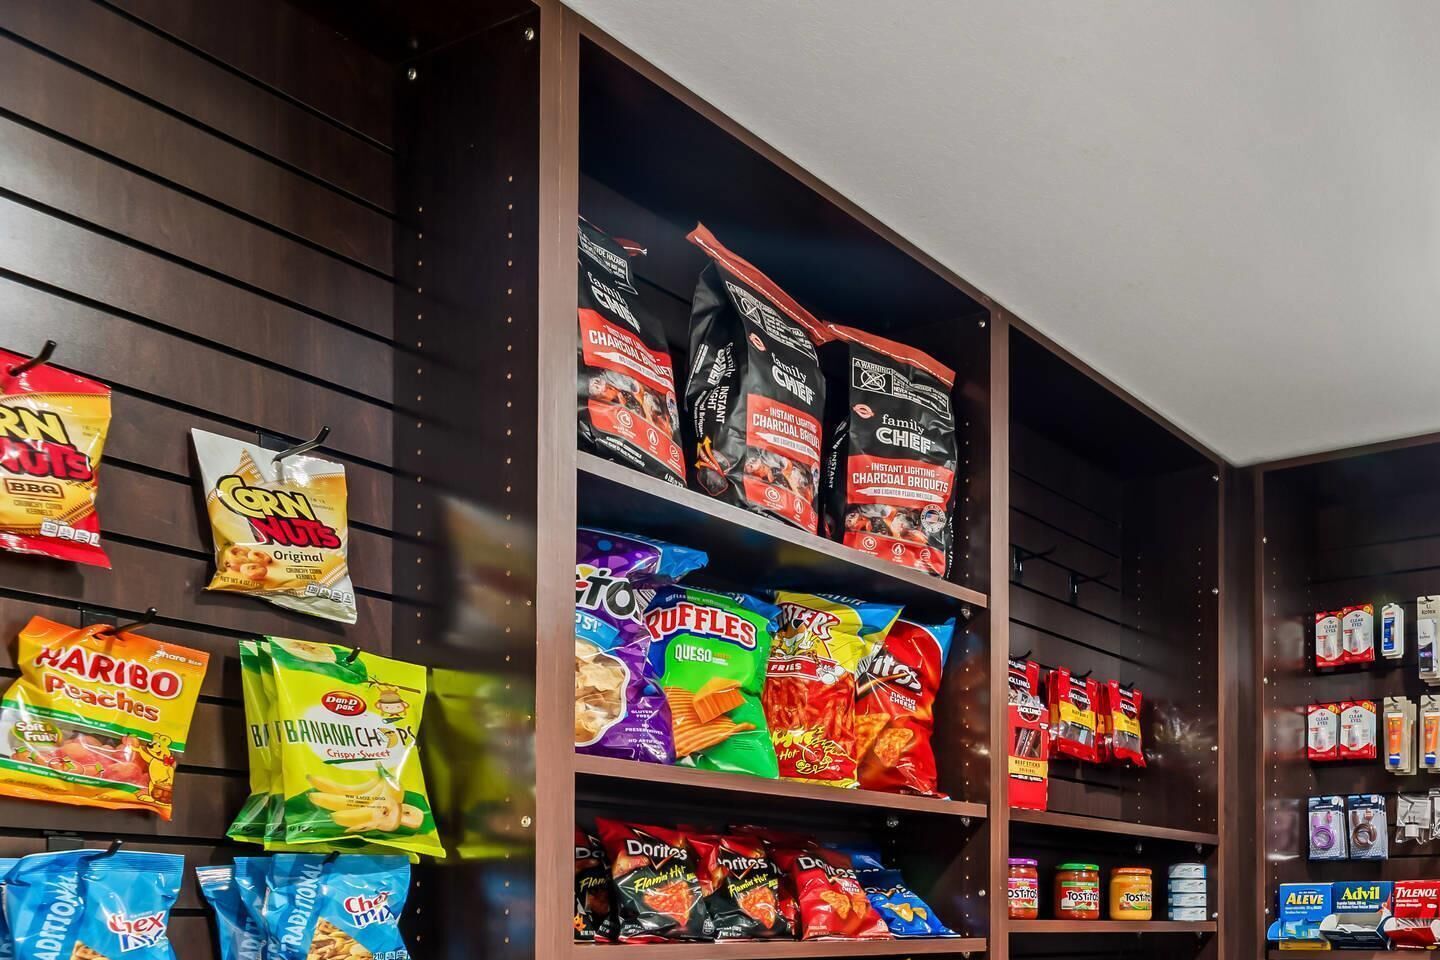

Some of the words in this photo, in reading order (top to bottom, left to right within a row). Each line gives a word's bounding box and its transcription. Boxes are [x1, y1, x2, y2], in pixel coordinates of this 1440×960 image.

[771, 352, 807, 382] family
[862, 362, 891, 375] WARNING
[771, 365, 815, 406] CHEF
[715, 385, 730, 424] INSTANT
[769, 407, 796, 424] INSTANT
[752, 413, 799, 438] CHARCOAL
[881, 413, 925, 435] family
[876, 427, 932, 455] CHEF
[871, 462, 903, 474] INSTANT
[904, 467, 936, 479] LIGHTING
[9, 482, 60, 495] BBQ
[852, 471, 906, 487] CHARCOAL
[908, 476, 950, 494] BRIQUETS
[216, 475, 317, 521] CORN
[249, 516, 342, 549] NUTS
[273, 550, 325, 563] Original
[646, 603, 756, 646] RUFFLES
[674, 643, 712, 663] QUESO
[34, 645, 182, 699] HARIBO
[770, 663, 803, 672] FRIES
[43, 672, 160, 723] Peaches
[15, 720, 46, 733] Soft
[284, 719, 356, 747] BANANA
[326, 748, 356, 760] Crispy
[359, 749, 391, 760] Sweet
[626, 839, 688, 861] Doritos
[800, 856, 857, 880] Doritos
[633, 873, 669, 894] Flamin'
[1342, 886, 1380, 901] Advil
[1395, 886, 1437, 899] TYLENOL
[280, 862, 324, 952] TRADITIONAL
[344, 891, 389, 915] Chex
[1286, 892, 1324, 906] ALEVE
